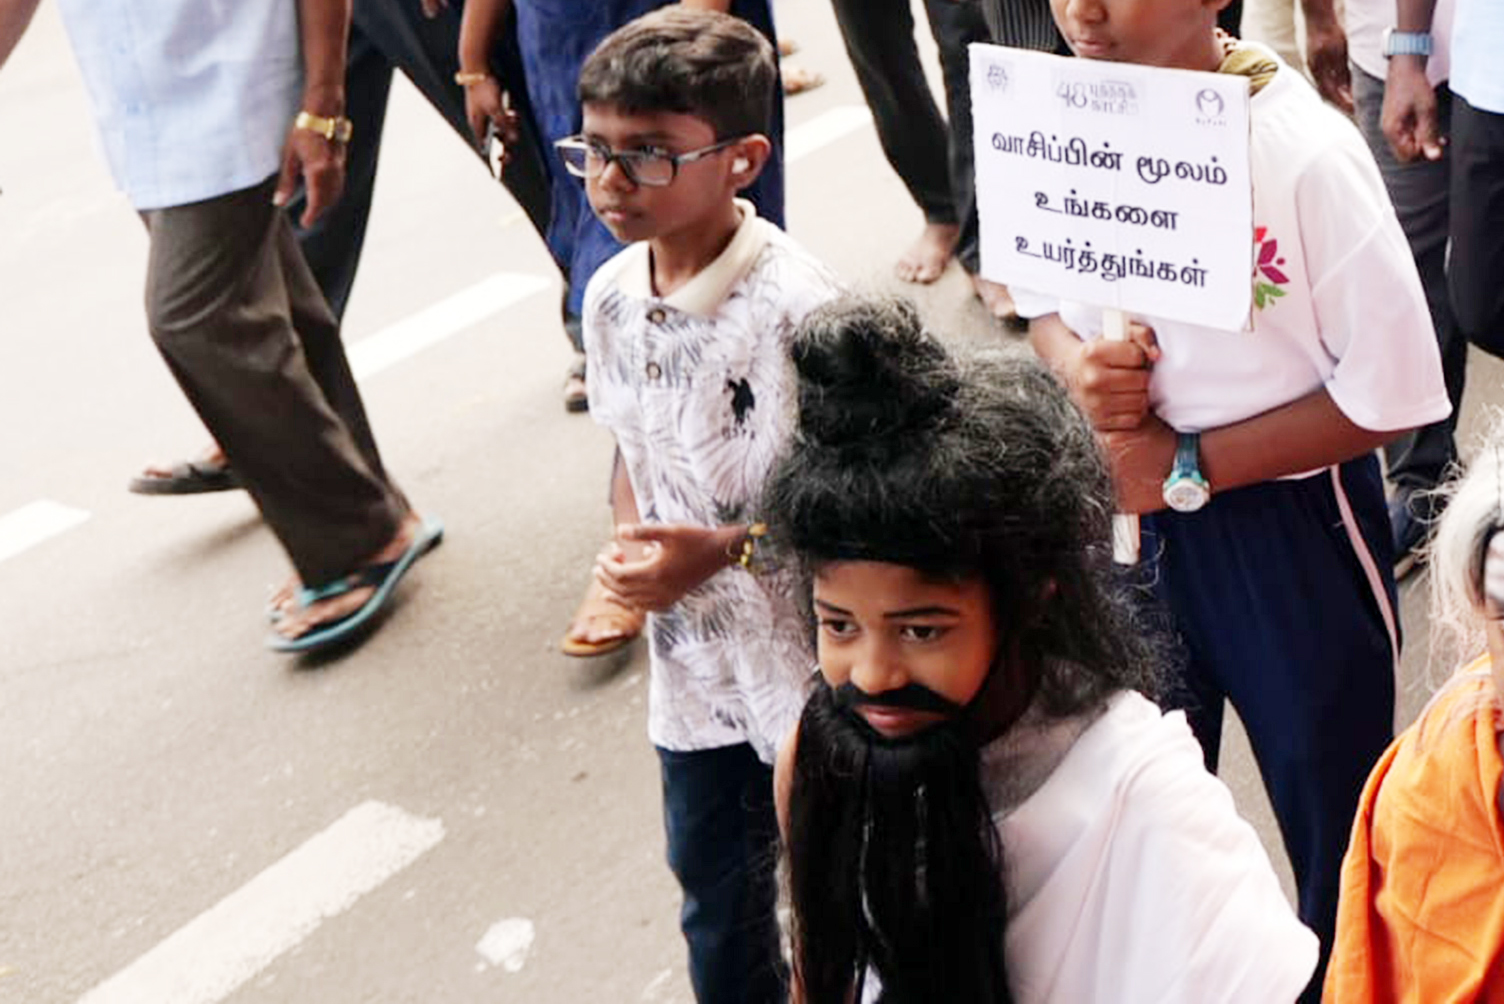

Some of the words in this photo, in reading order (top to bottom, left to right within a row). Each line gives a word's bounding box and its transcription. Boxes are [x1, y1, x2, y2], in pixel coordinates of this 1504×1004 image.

[991, 130, 1123, 172] வாசிப்பின்
[1136, 156, 1228, 185] மூலம்
[1034, 188, 1180, 231] உங்களை
[1015, 235, 1209, 288] உயர்த்துங்கள்
